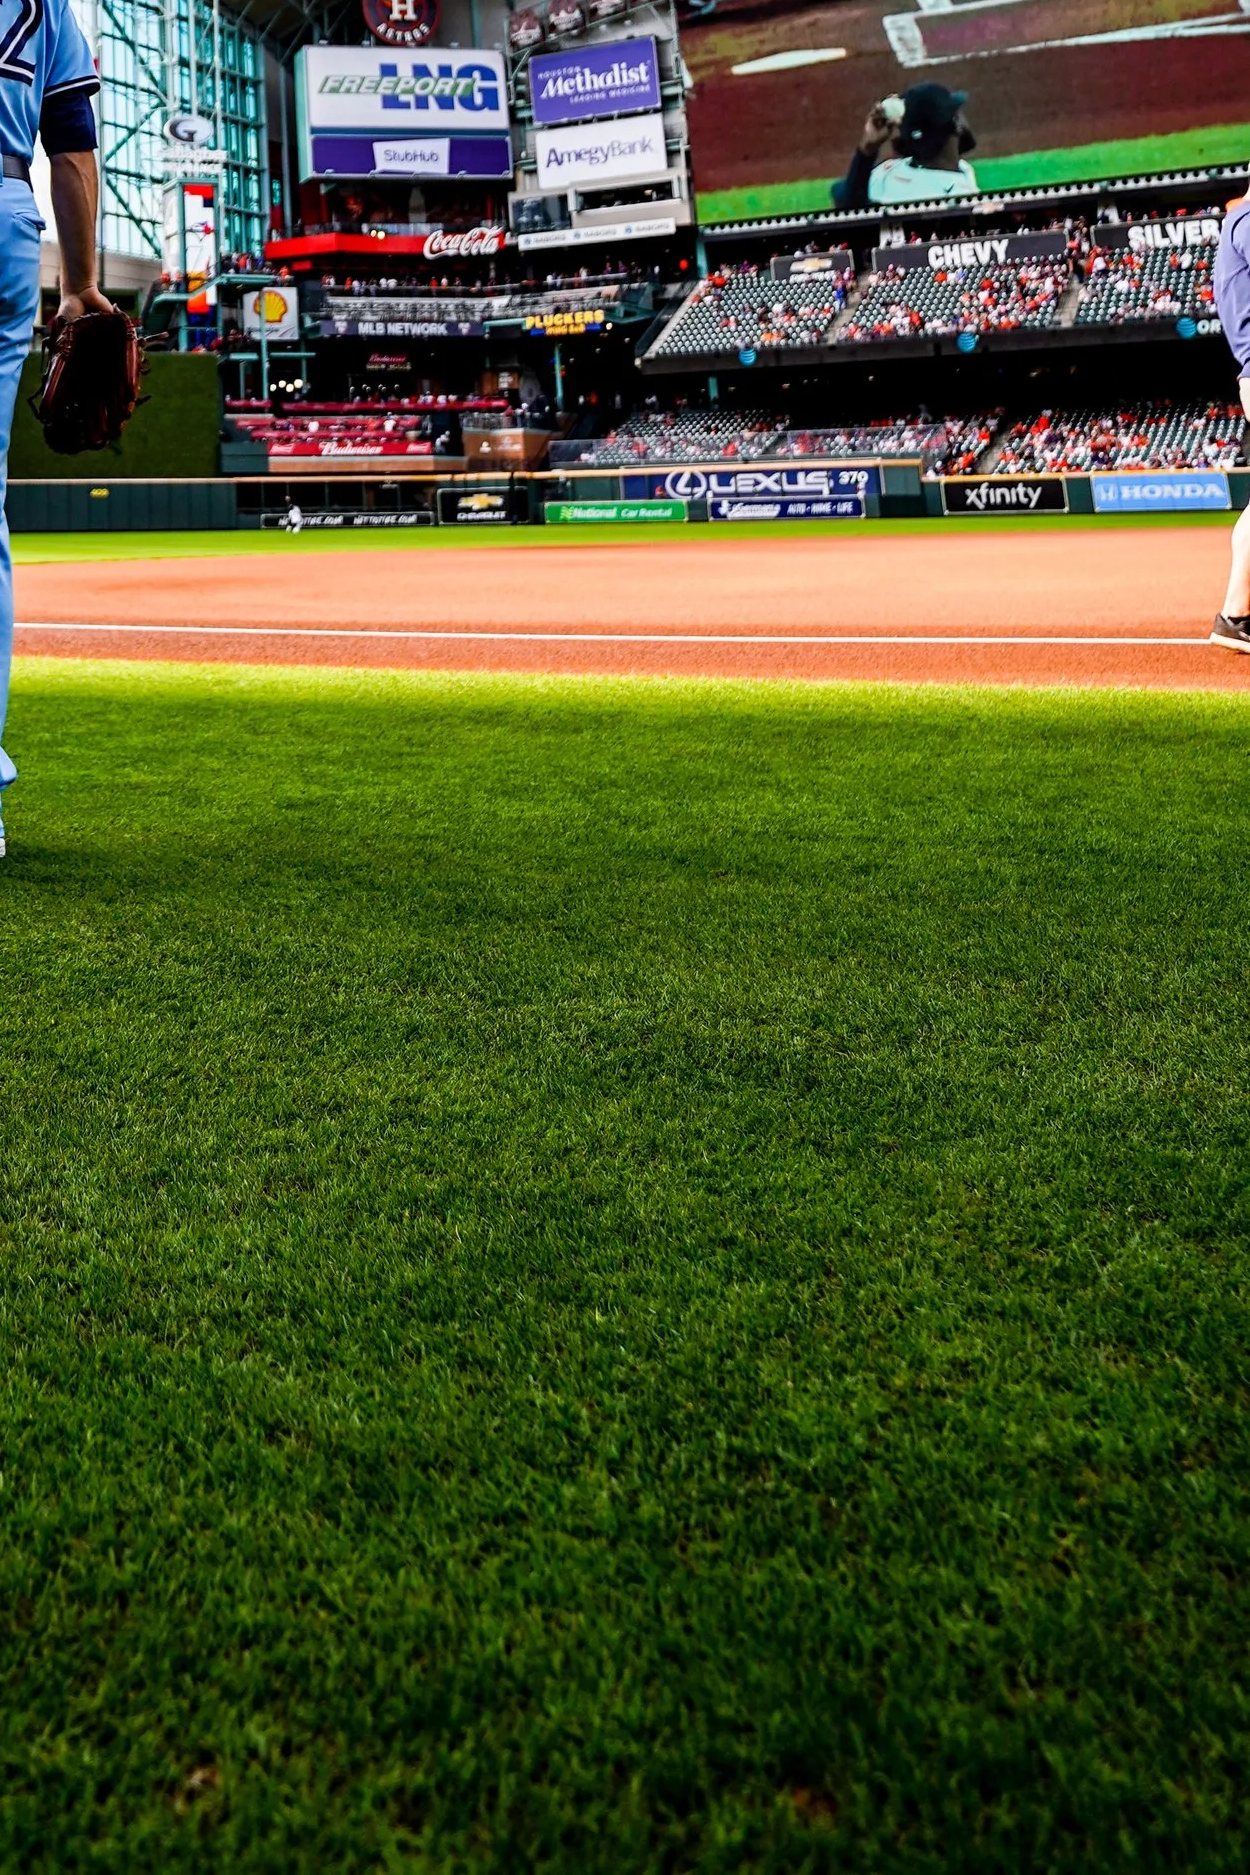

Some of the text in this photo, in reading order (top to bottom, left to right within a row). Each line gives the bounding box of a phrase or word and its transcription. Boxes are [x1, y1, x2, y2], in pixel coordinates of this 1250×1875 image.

[377, 23, 430, 42] ASTROS
[321, 76, 468, 96] FREEPORT
[379, 63, 500, 111] LNG
[540, 61, 650, 99] Methodist
[383, 149, 440, 163] StubHub
[927, 238, 1010, 268] CHEVY
[358, 322, 448, 336] MLB NETWORK
[525, 309, 605, 330] PLUCKERS
[710, 471, 869, 493] LEXUS 370
[1121, 482, 1225, 501] HONDA
[965, 482, 1042, 510] xfinity
